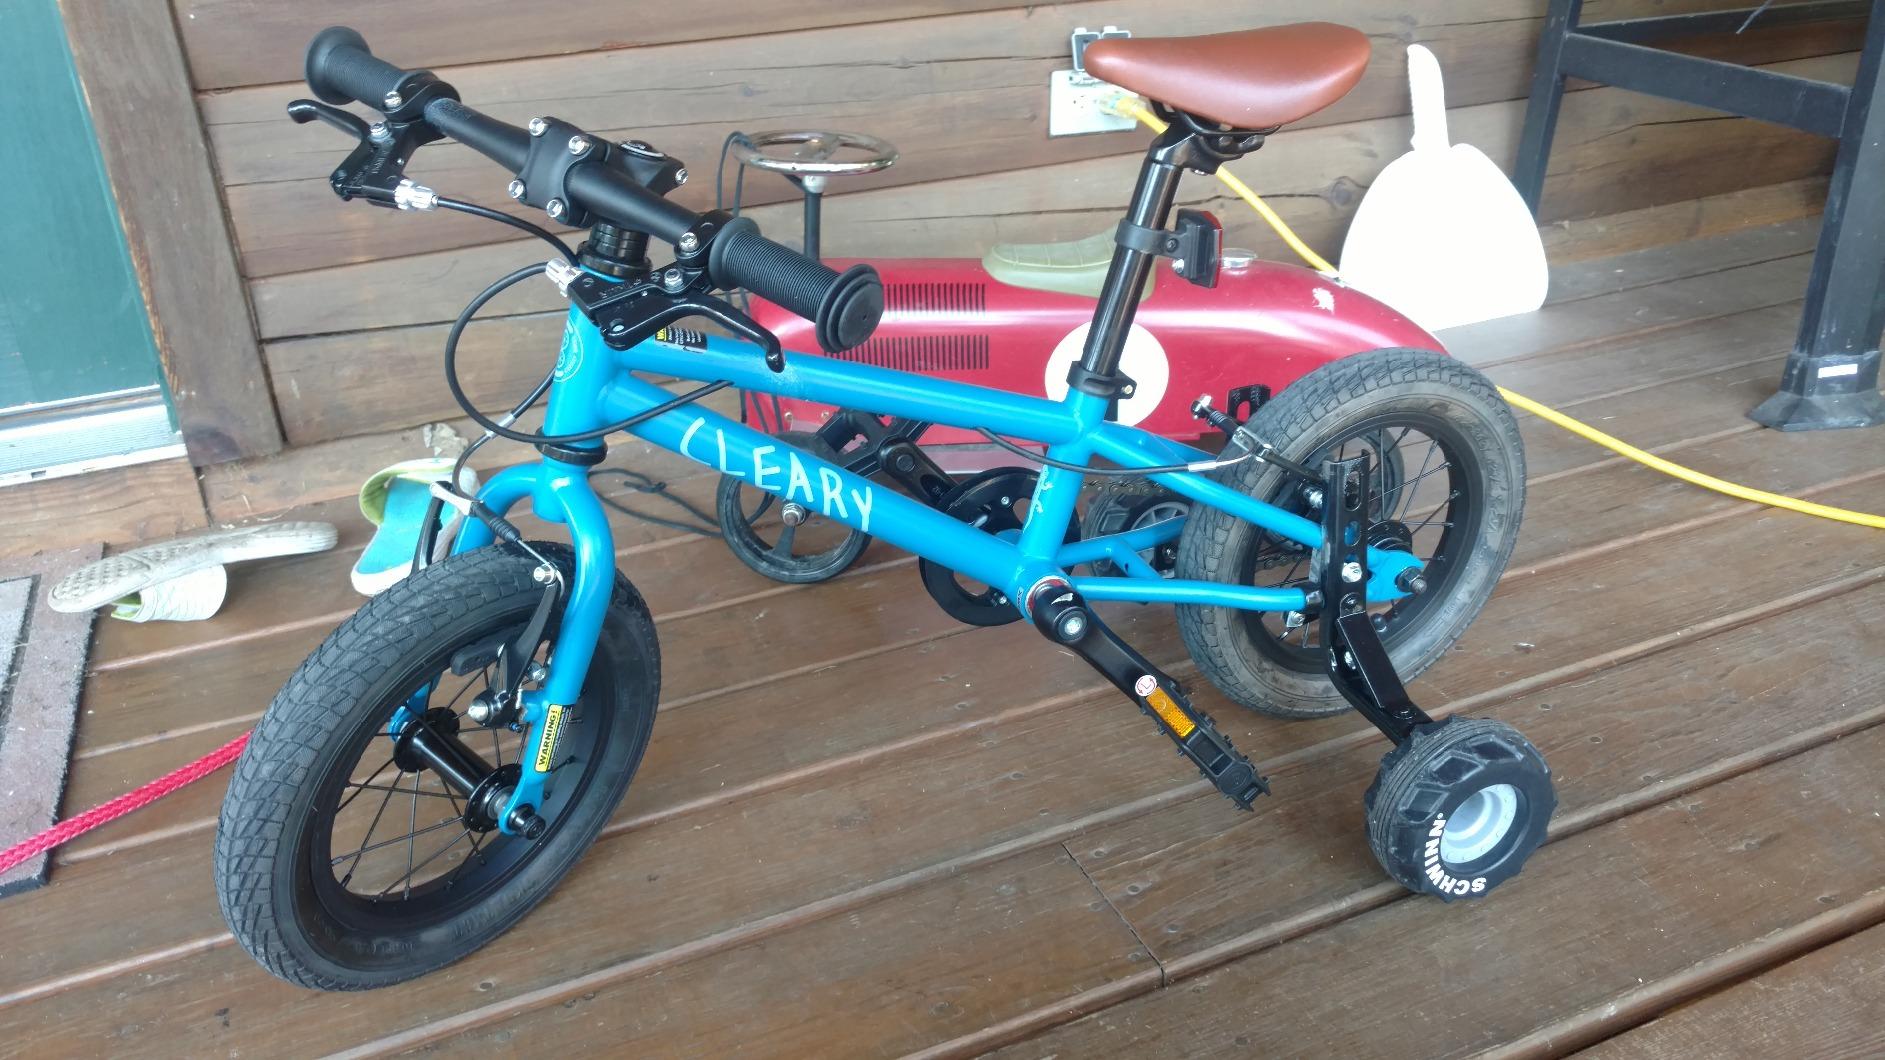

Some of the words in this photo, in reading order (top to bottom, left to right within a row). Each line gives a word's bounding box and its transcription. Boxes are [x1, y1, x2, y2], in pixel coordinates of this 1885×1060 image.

[679, 416, 873, 532] CLEARY
[538, 709, 558, 766] WARNING!
[1424, 818, 1487, 896] SCHWINN
